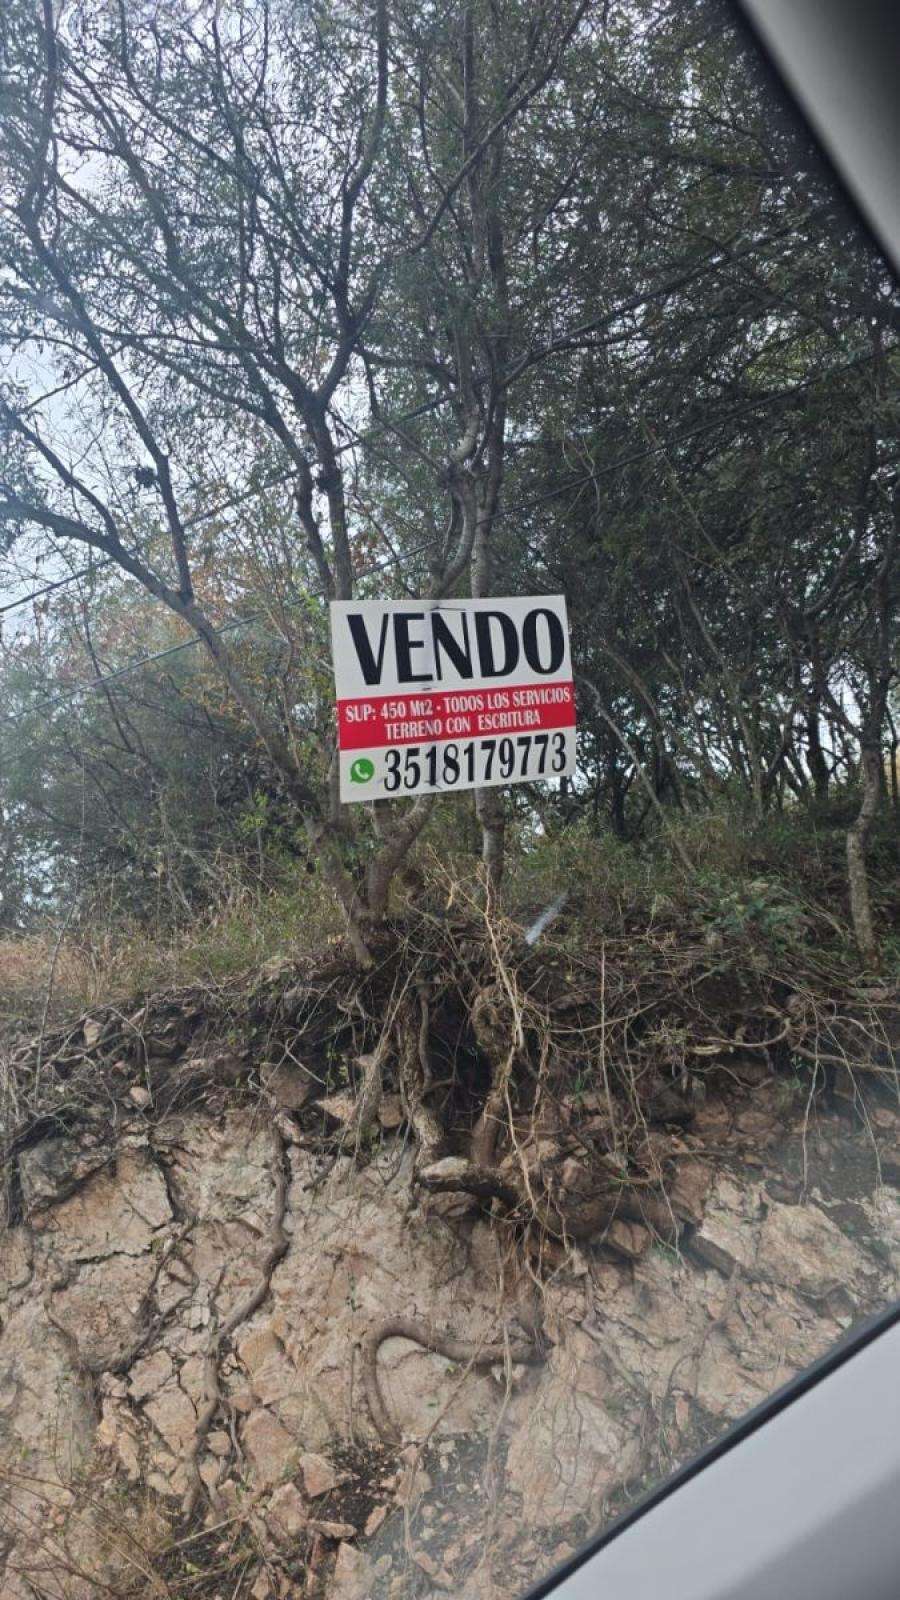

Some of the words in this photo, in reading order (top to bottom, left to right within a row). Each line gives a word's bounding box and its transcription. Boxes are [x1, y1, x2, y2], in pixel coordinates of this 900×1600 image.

[347, 608, 565, 685] VENDO
[345, 704, 377, 723] SUP:
[380, 701, 406, 720] 450
[410, 699, 433, 717] Mt2
[443, 694, 485, 713] TODOS
[487, 692, 509, 710] LOS
[512, 687, 571, 708] SERVICIOS
[385, 720, 443, 740] TERRENO
[446, 717, 471, 734] CON
[477, 710, 541, 731] ESCRITURA
[383, 732, 567, 792] 3518179773
